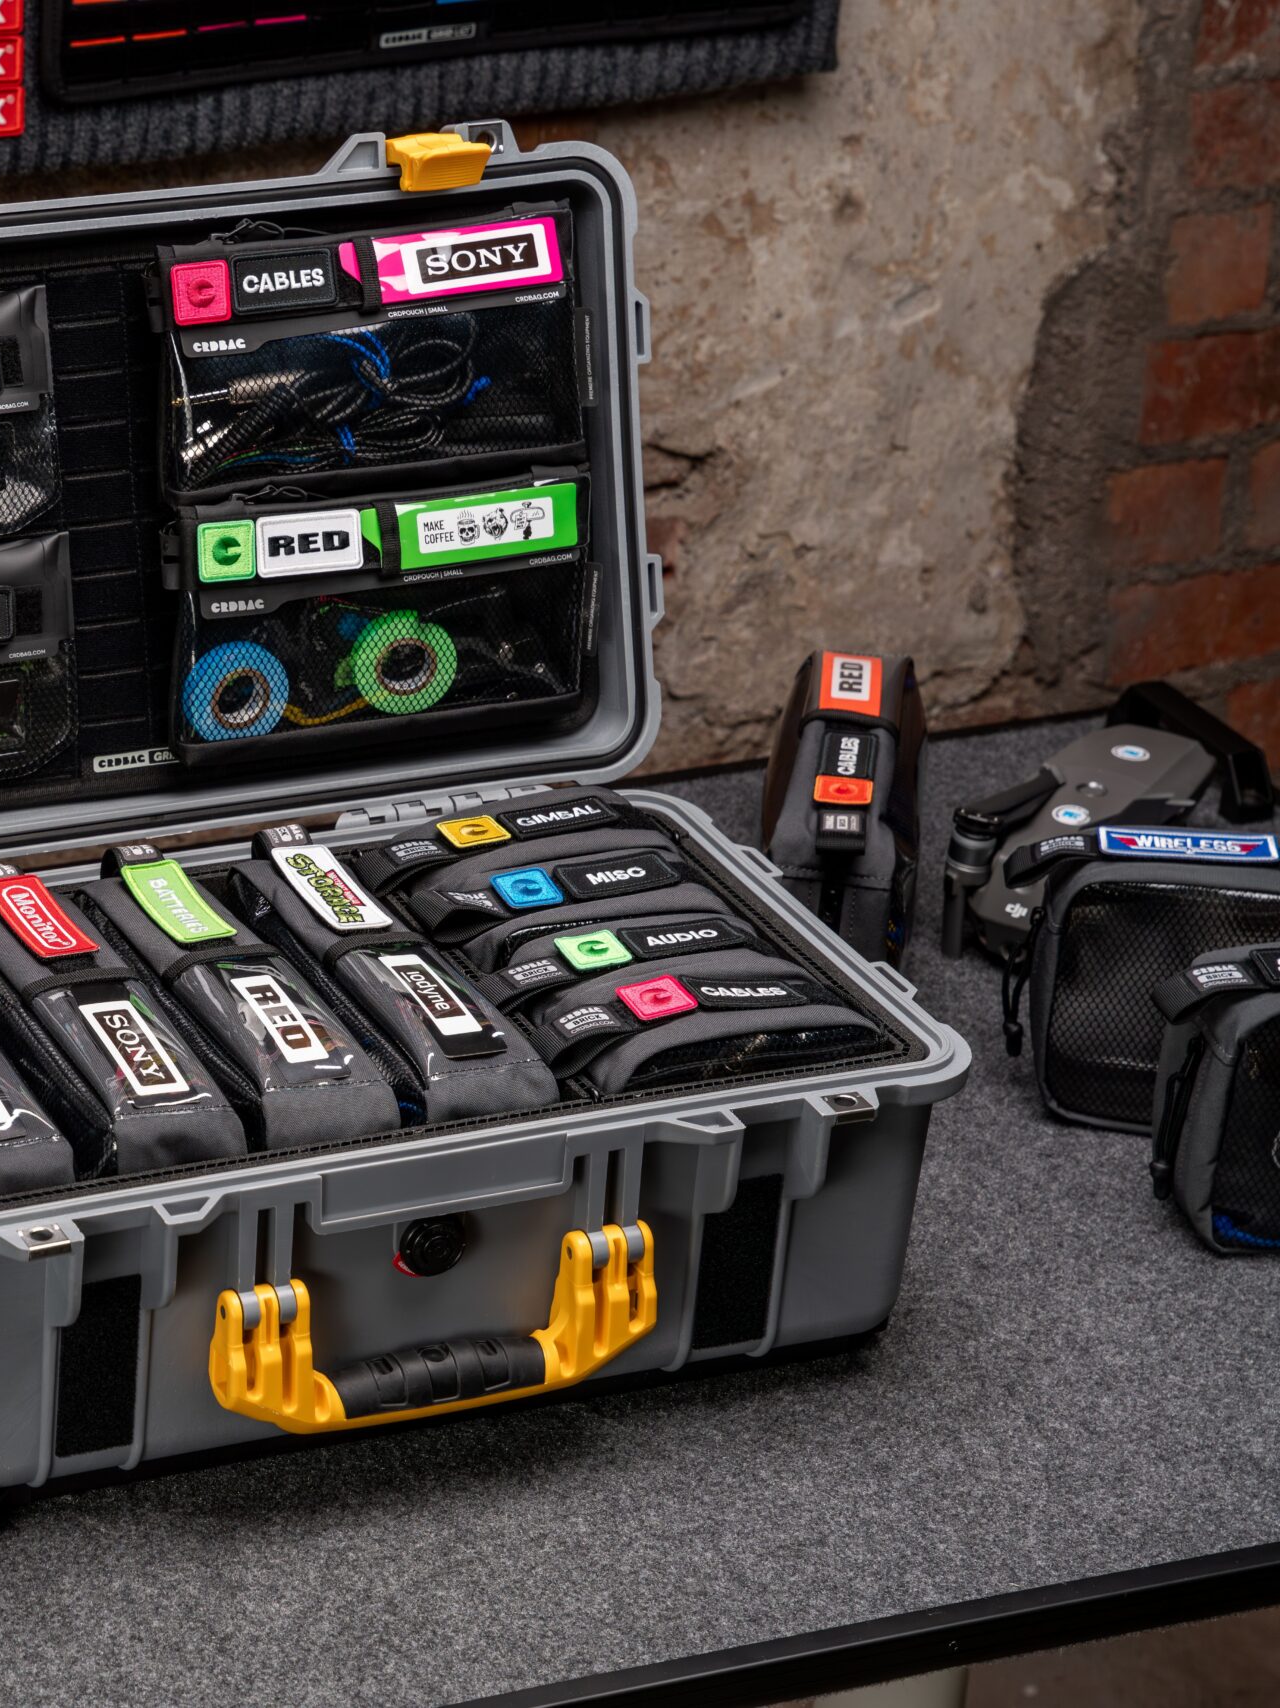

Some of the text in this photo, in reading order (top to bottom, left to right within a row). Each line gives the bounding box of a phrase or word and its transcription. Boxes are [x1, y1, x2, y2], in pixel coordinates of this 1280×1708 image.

[425, 242, 528, 275] SONY
[242, 268, 325, 295] CABLES
[426, 306, 448, 315] SMALL
[192, 338, 246, 353] CRDBAG
[423, 520, 445, 532] MAKE
[267, 531, 350, 557] RED
[424, 531, 455, 545] COFFEE
[443, 568, 464, 578] SMALL
[210, 599, 265, 614] CRDBAG
[839, 661, 863, 693] RED
[98, 754, 146, 768] CRDBAG
[838, 736, 860, 775] CABLES
[517, 804, 601, 827] GIMBAL
[1136, 835, 1242, 852] WIRELESS
[586, 866, 647, 885] MISC
[285, 853, 366, 923] STORAGE
[148, 877, 209, 935] BATTERIES
[10, 891, 62, 945] Monitor
[646, 929, 718, 947] AUDIO
[521, 967, 551, 978] BRICK
[700, 985, 787, 997] CABLES
[245, 984, 313, 1050] RED
[572, 1014, 602, 1026] BRICK
[104, 1013, 166, 1081] SONY
